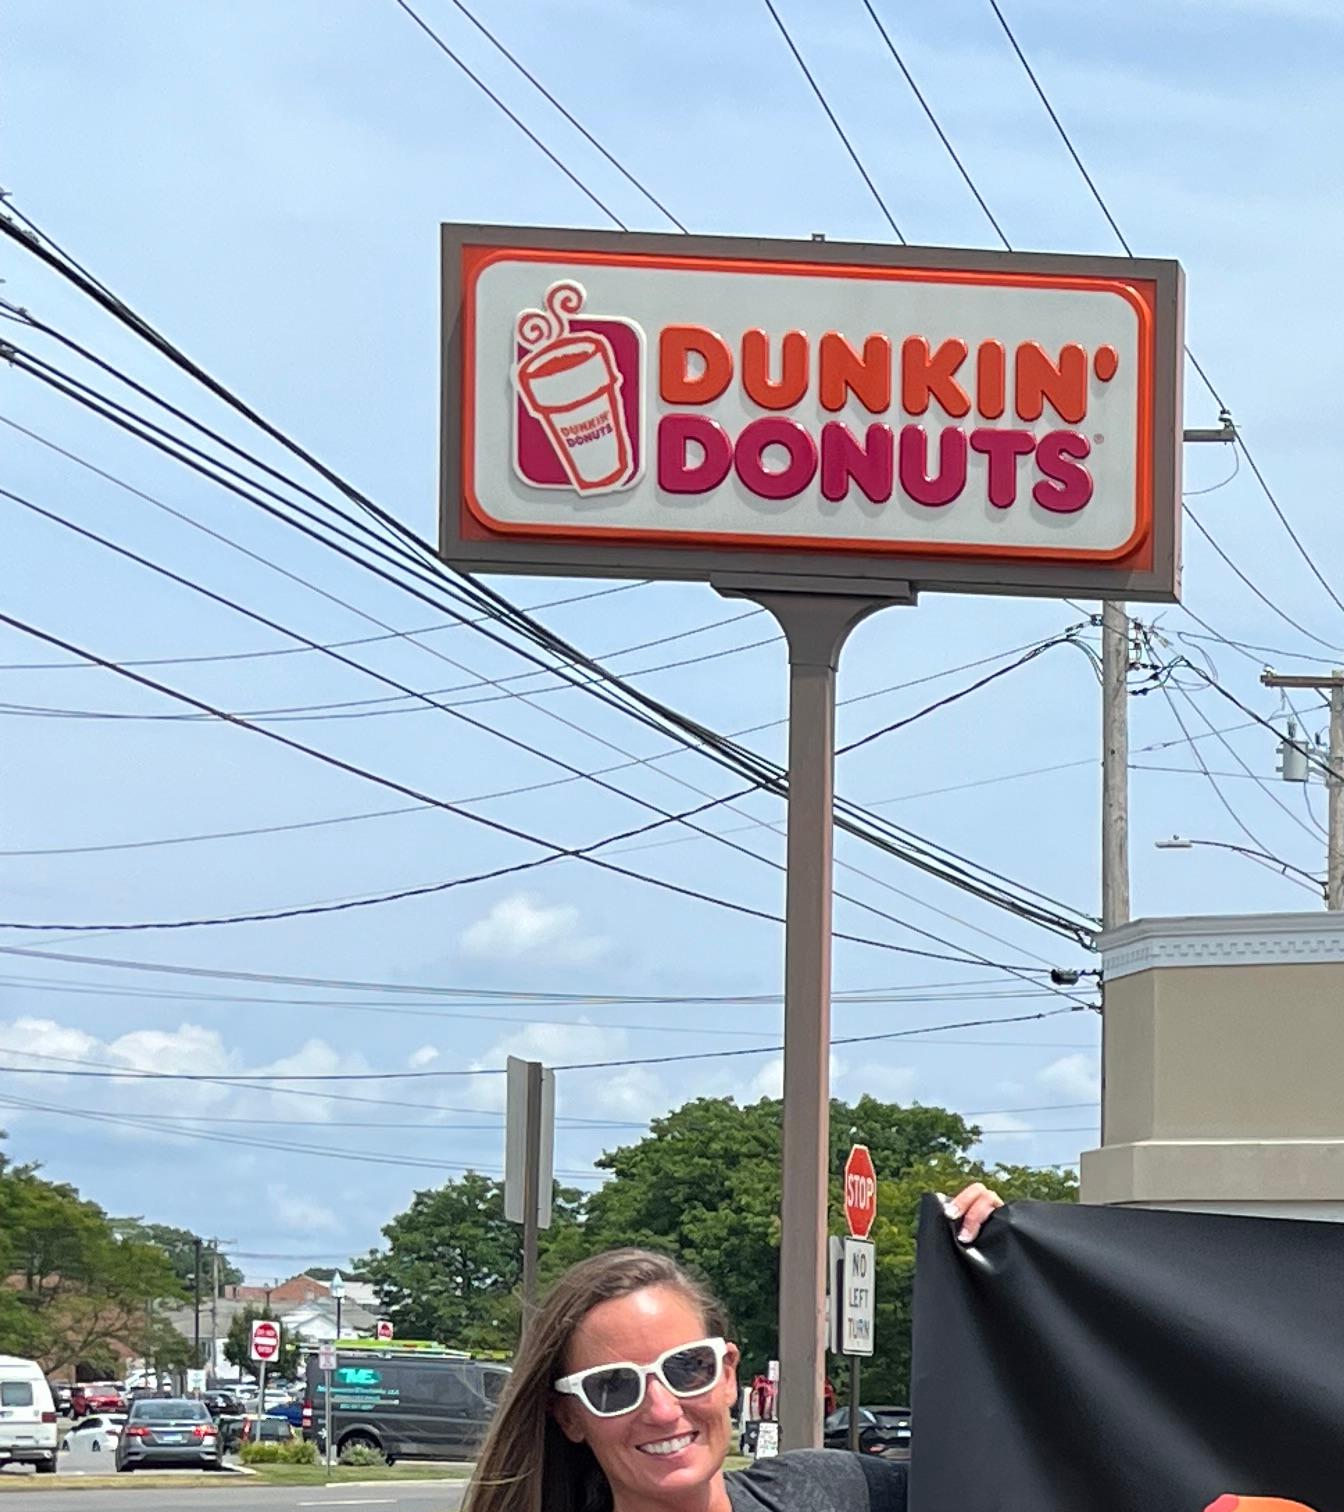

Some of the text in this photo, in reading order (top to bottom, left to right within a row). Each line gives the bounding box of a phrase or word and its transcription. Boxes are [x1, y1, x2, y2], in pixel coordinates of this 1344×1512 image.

[657, 323, 1119, 423] DUNKIN'
[657, 411, 1093, 513] DONUTS
[847, 1173, 874, 1210] STOP
[852, 1253, 867, 1278] NO
[849, 1287, 869, 1309] LEFT
[848, 1317, 870, 1340] TURN
